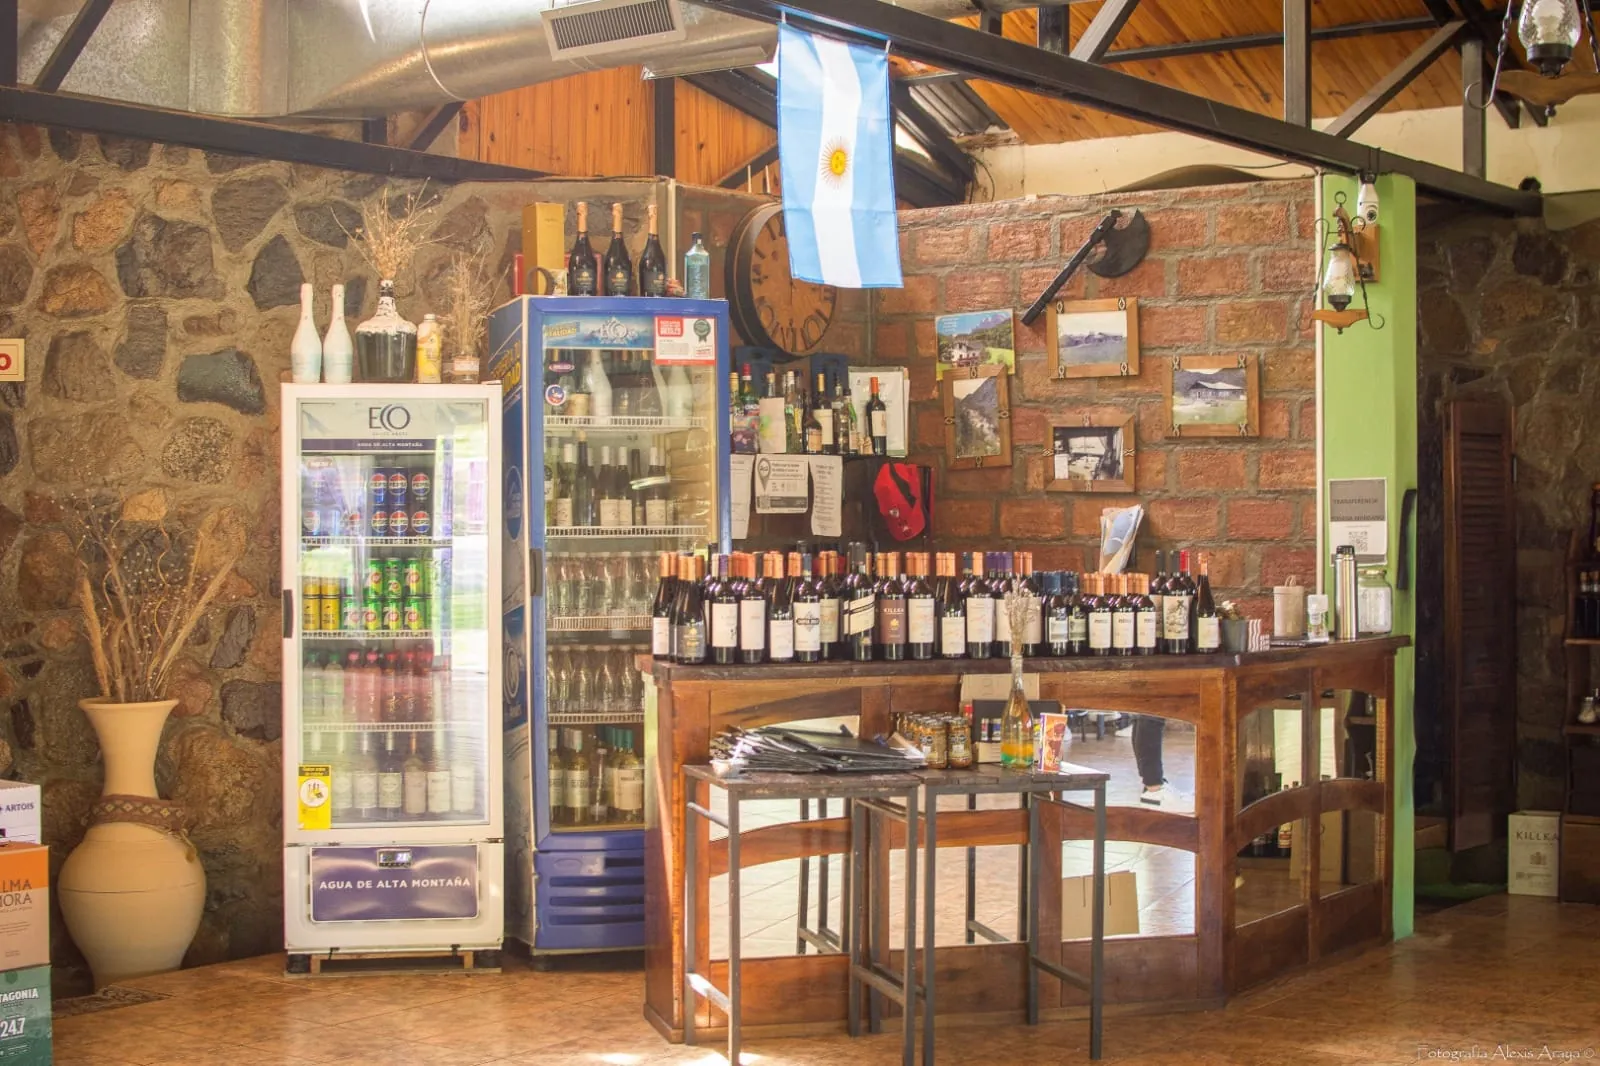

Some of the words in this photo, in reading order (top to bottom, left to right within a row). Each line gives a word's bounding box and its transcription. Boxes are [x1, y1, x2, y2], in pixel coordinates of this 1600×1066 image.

[369, 404, 411, 432] ECO
[5, 802, 34, 812] ARTOIS
[1516, 831, 1559, 841] KILLKA
[319, 881, 352, 890] AGUA
[357, 880, 372, 889] DE
[376, 879, 408, 888] ALTA
[412, 877, 471, 887] MONTAÑA
